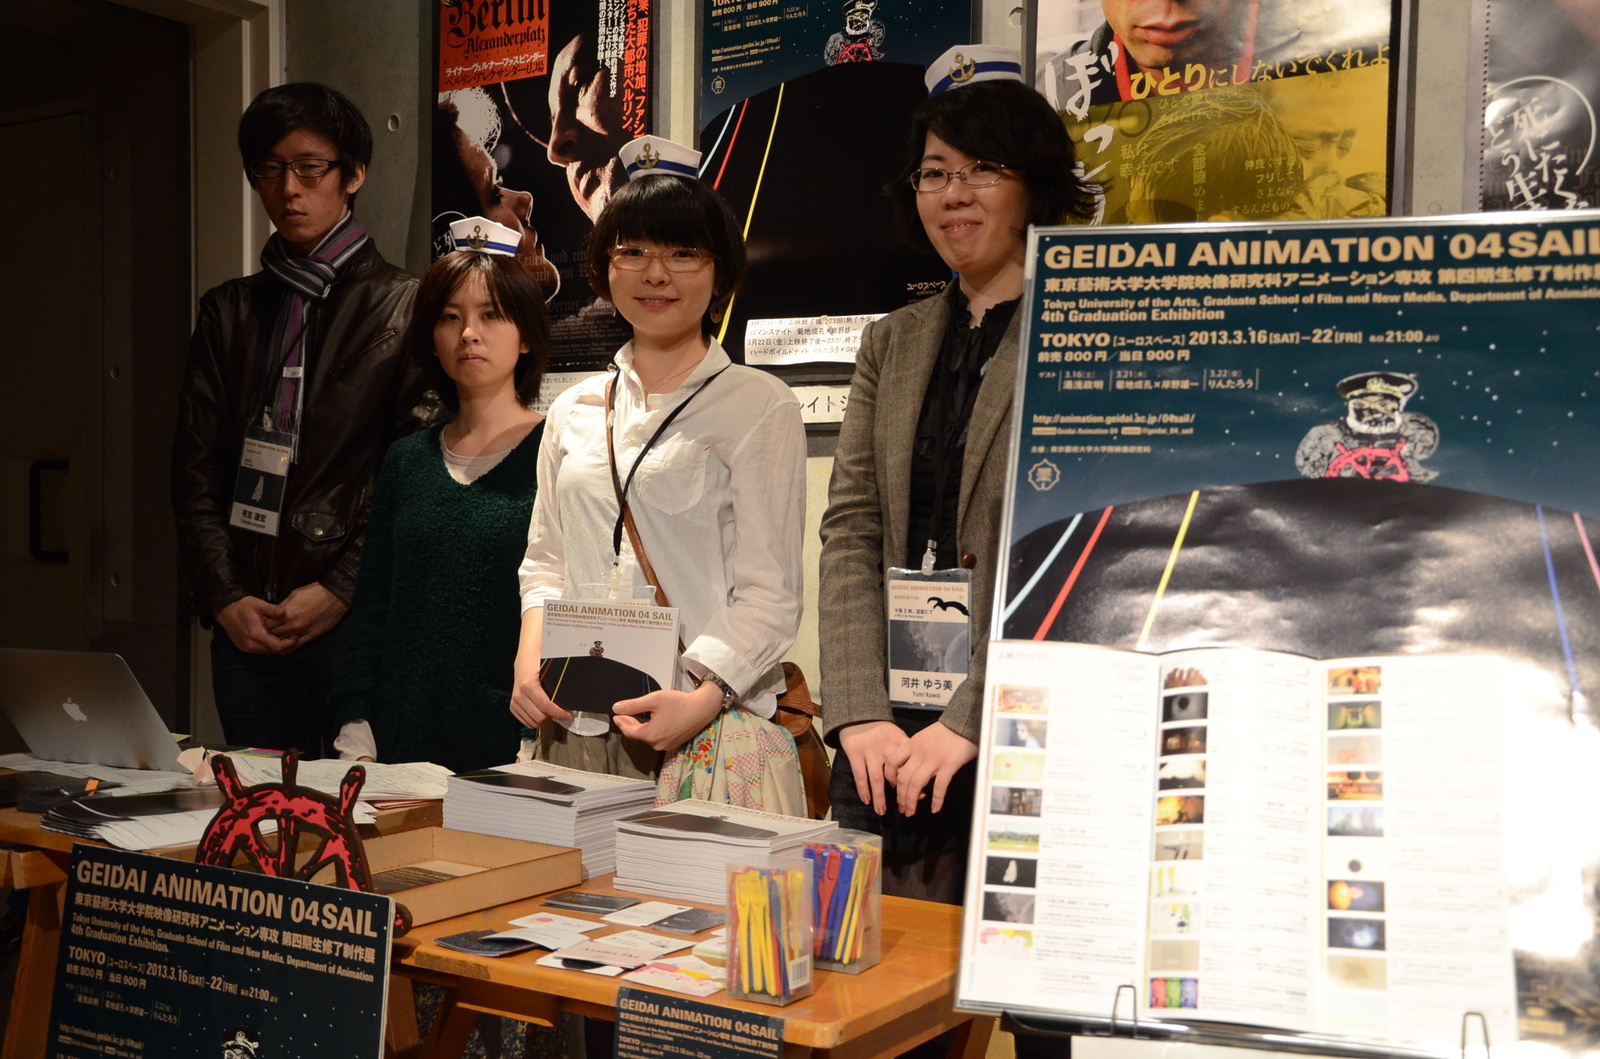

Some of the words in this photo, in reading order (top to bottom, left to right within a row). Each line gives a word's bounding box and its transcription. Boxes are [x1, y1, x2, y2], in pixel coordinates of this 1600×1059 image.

[633, 0, 649, 139] 業、犯罪の増加、ファシ
[1130, 42, 1390, 100] ひとりにしないでくれよ
[1044, 243, 1177, 269] GEIDAI
[1188, 235, 1434, 267] ANIMATION
[1043, 298, 1076, 311] Tokyo
[1078, 298, 1136, 311] University
[1138, 297, 1150, 308] of
[1151, 297, 1171, 308] the
[1173, 296, 1200, 308] Arts,
[1203, 295, 1257, 307] Graduate
[1258, 293, 1300, 305] School
[1302, 293, 1315, 304] of
[1316, 293, 1344, 304] Film
[1346, 293, 1371, 304] and
[1372, 292, 1400, 303] New
[1402, 291, 1447, 304] Media,
[1450, 289, 1526, 303] Department
[1528, 289, 1541, 300] of
[1041, 310, 1065, 323] 4th
[1068, 308, 1148, 323] Graduation
[1151, 307, 1225, 322] Exhibition
[1040, 333, 1111, 348] TOKYO
[1208, 378, 1254, 389] りんたろう
[547, 603, 578, 613] GEIDAI
[581, 606, 636, 618] ANIMATION
[638, 610, 650, 619] 04
[652, 611, 673, 622] SAIL
[901, 676, 920, 689] 河井
[923, 678, 953, 691] ゆう美
[77, 860, 147, 893] GEIDAI
[152, 873, 284, 919] ANIMATION
[71, 924, 83, 936] 4th
[85, 926, 127, 945] Graduation
[129, 934, 168, 953] Exhibition
[73, 912, 91, 924] Tokyo
[92, 915, 121, 931] University
[122, 923, 129, 932] of
[130, 924, 140, 933] the
[157, 928, 184, 943] Graduate
[186, 934, 207, 948] School
[208, 938, 216, 949] of
[216, 940, 231, 952] Film
[232, 944, 244, 955] and
[246, 945, 260, 959] New
[287, 954, 327, 973] Department
[328, 964, 336, 975] of
[337, 966, 374, 983] Animation
[68, 945, 106, 965] TOKYO
[620, 998, 659, 1015] GEIDAI
[662, 1006, 732, 1030] ANIMATION
